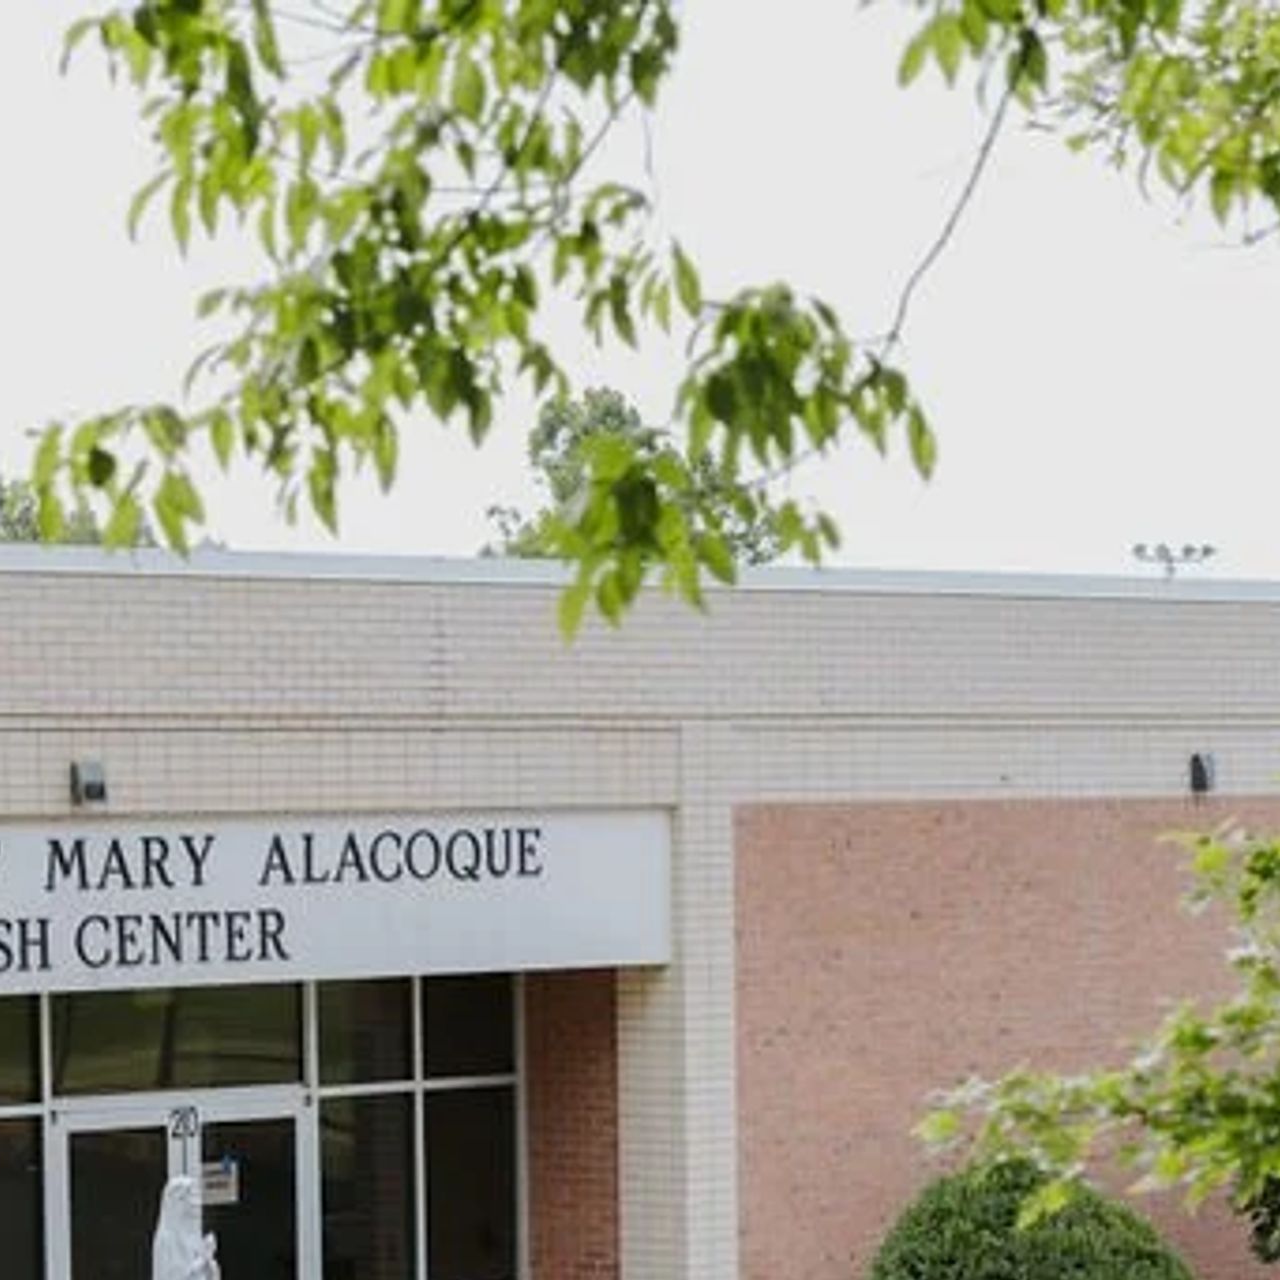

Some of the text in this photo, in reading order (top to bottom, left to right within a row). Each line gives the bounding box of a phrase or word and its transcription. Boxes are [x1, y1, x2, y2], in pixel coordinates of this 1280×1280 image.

[44, 834, 217, 893] MARY
[259, 827, 543, 887] ALACOQUE
[74, 908, 290, 970] CENTER
[168, 1106, 199, 1138] 20
